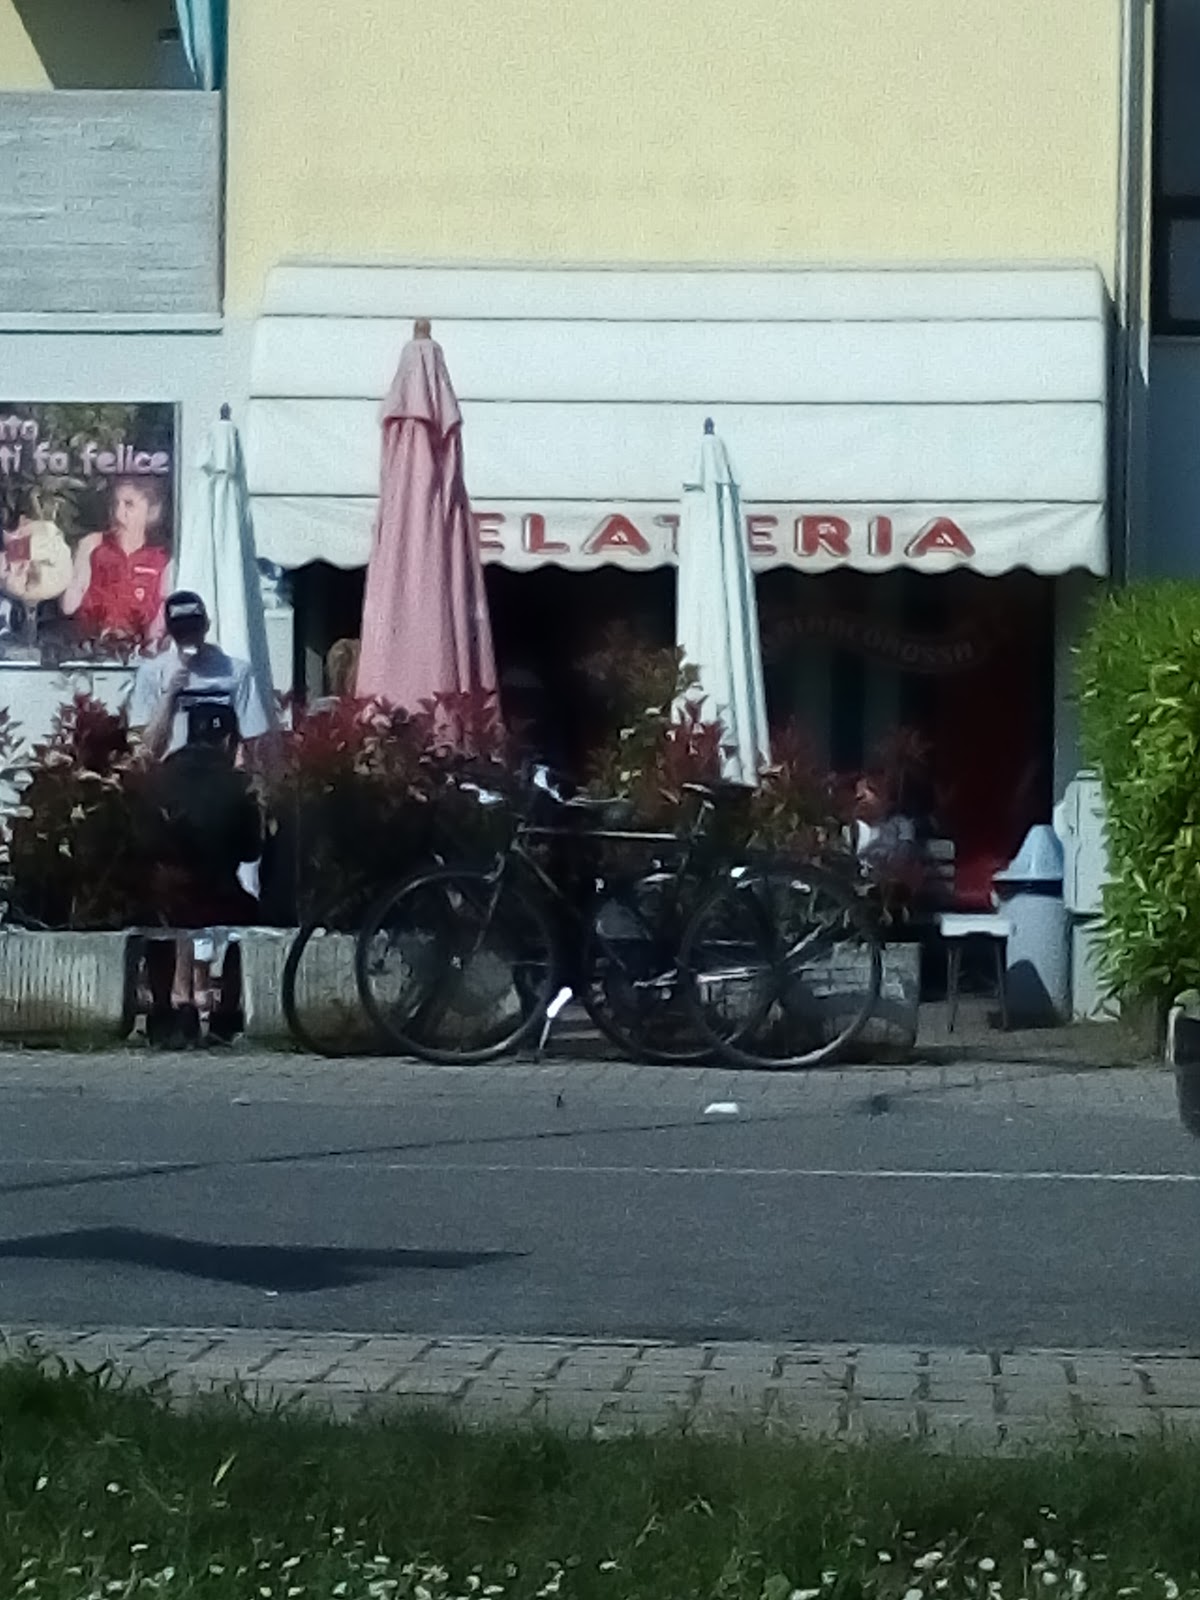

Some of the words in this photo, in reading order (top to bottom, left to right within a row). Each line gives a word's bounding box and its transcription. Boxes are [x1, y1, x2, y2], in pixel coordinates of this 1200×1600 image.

[33, 441, 69, 475] fa
[81, 442, 169, 475] felice
[471, 511, 976, 557] ELATERIA
